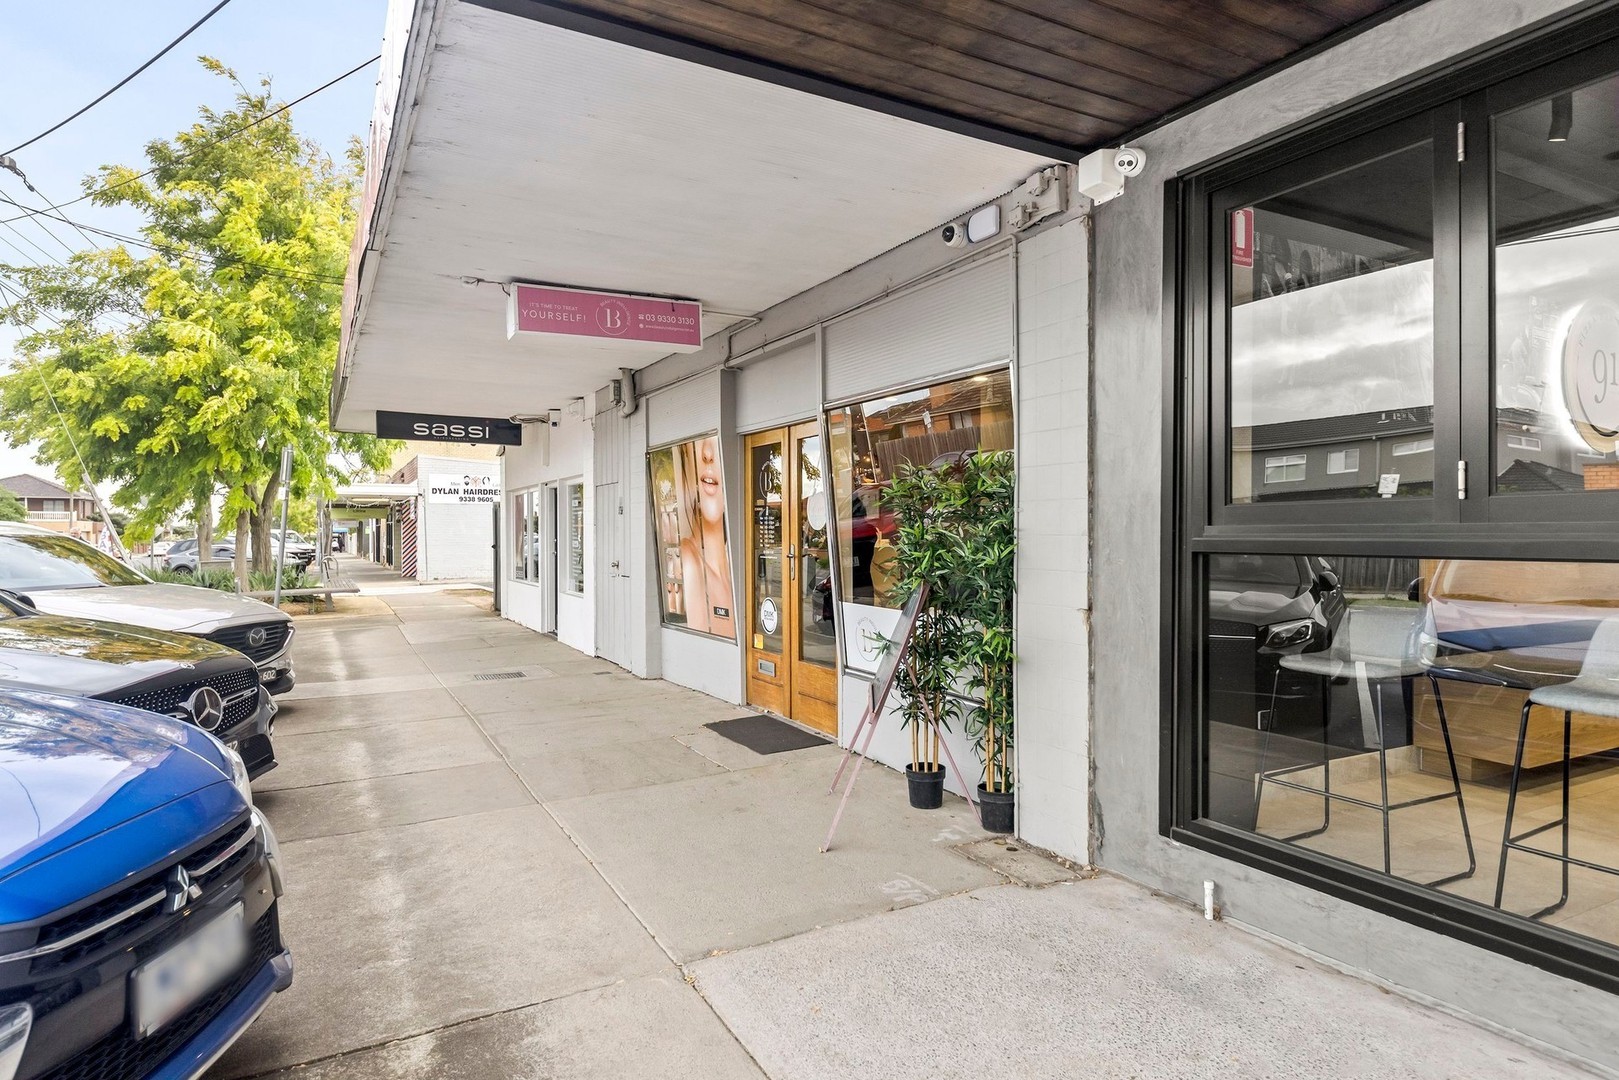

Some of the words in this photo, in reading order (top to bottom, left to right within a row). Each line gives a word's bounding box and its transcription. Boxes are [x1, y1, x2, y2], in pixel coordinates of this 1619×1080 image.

[522, 309, 586, 323] YOURSELF!
[645, 313, 656, 322] 03
[657, 315, 677, 323] 9330
[677, 316, 695, 325] 3130
[413, 422, 489, 439] sassi
[262, 670, 276, 681] 602
